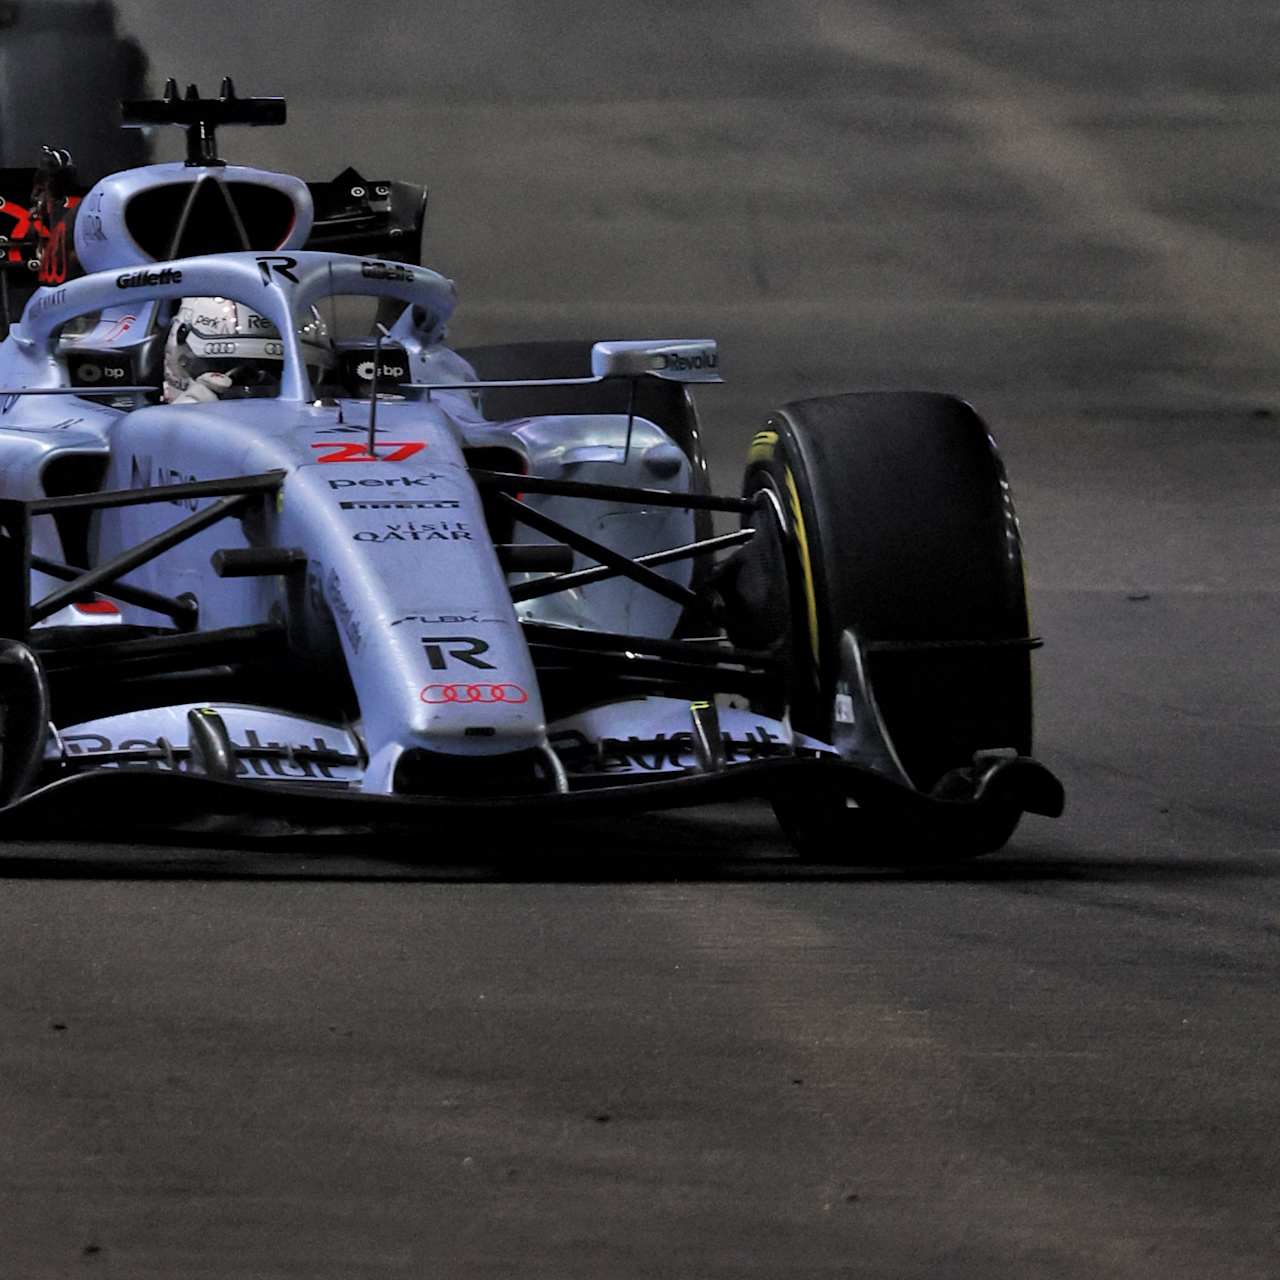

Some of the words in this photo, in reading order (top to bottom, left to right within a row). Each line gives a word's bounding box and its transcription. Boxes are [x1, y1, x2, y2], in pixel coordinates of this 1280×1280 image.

[116, 268, 183, 289] Gillette
[104, 367, 125, 380] bp
[383, 364, 404, 378] bp
[310, 442, 427, 463] 27
[386, 520, 470, 531] visit
[352, 530, 473, 543] QATAR
[420, 636, 498, 671] R
